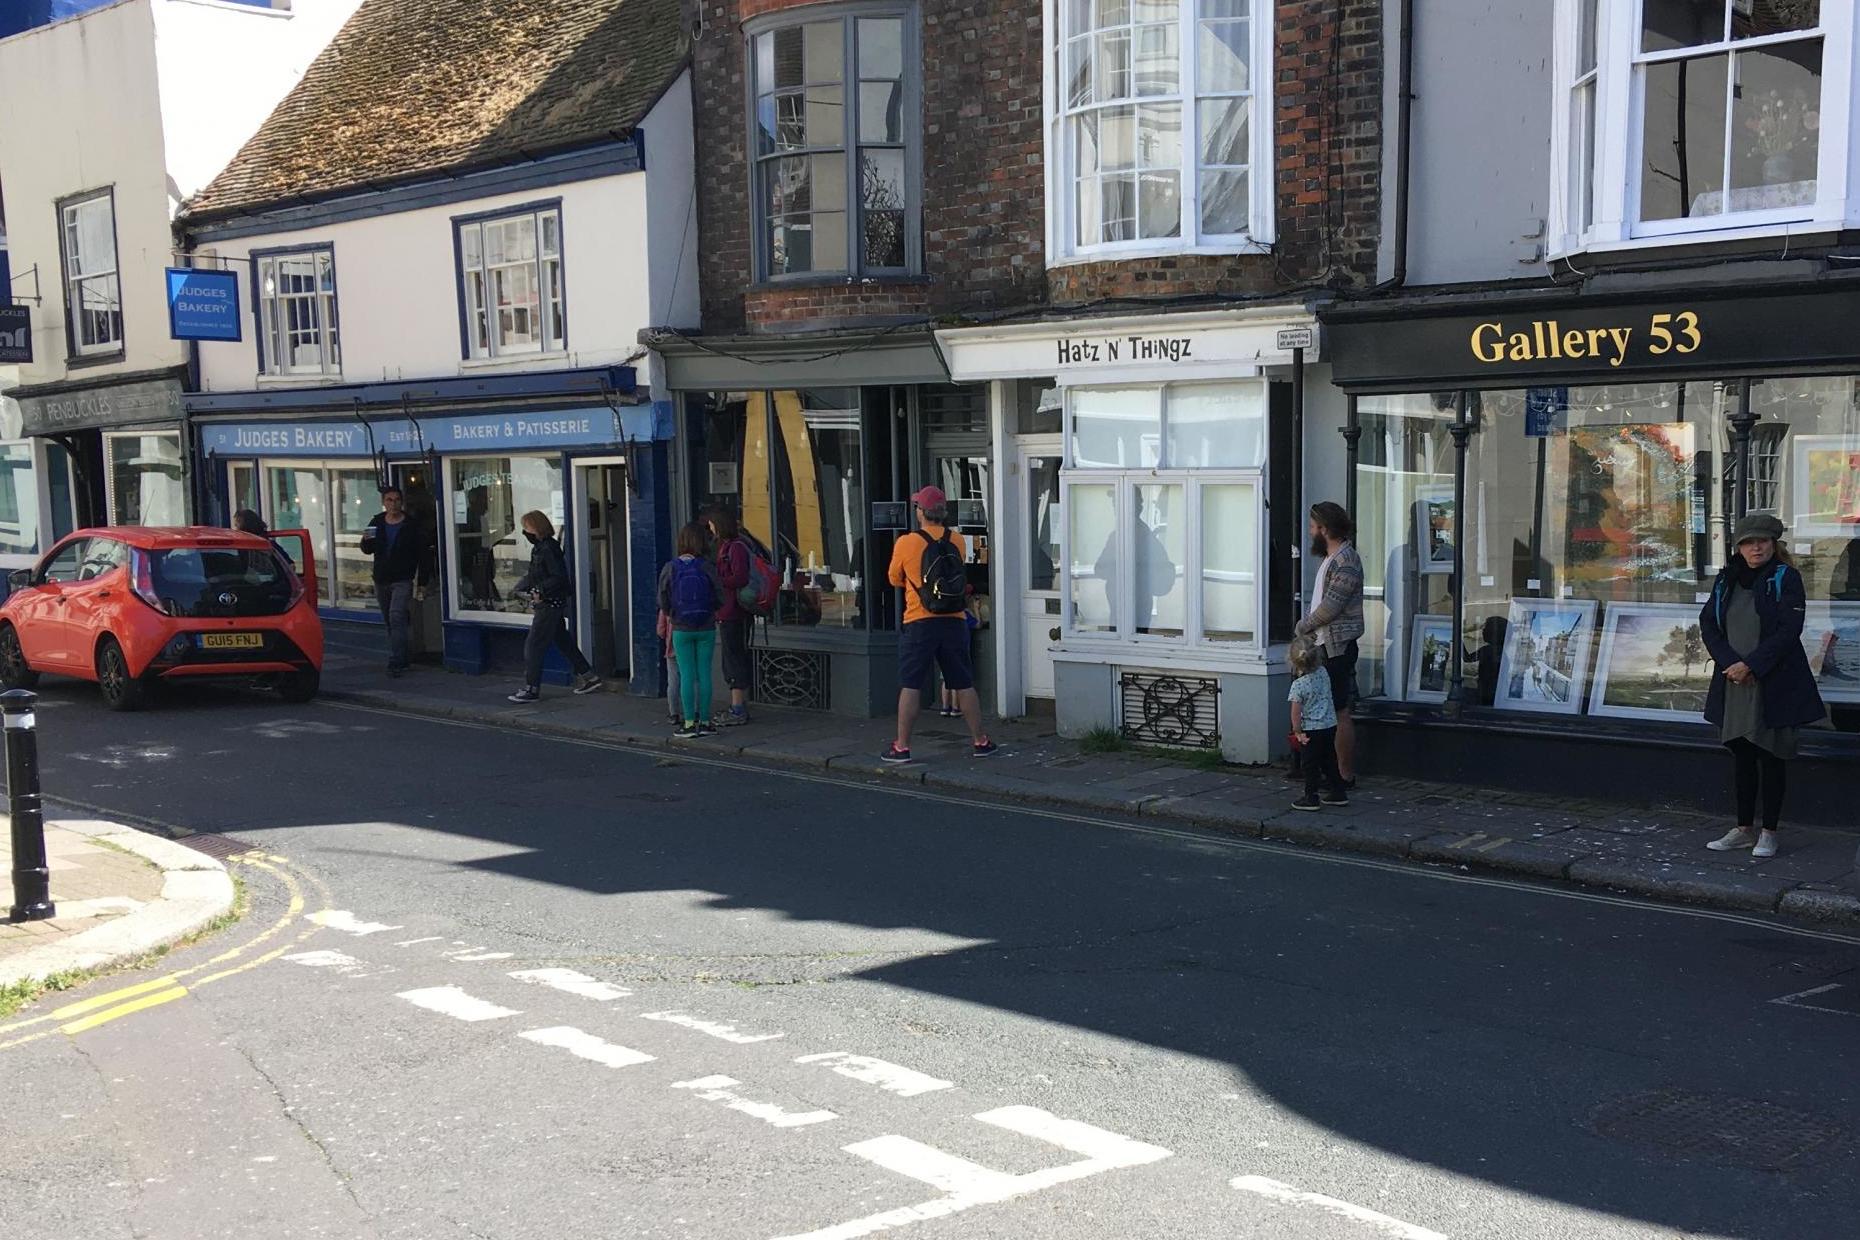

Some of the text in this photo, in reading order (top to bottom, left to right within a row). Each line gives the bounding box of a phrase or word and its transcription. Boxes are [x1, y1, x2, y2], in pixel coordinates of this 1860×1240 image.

[178, 286, 227, 298] JUDGES
[178, 302, 227, 313] BAKERY
[1470, 311, 1702, 367] Gallery 53
[1057, 339, 1100, 363] Hatz
[1104, 338, 1122, 361] 'N'
[47, 396, 113, 421] PENBUCKLES
[234, 428, 289, 448] JUDGES
[295, 428, 352, 448] BAKERY
[454, 419, 590, 439] BAKERY & PATISSERIE
[463, 473, 499, 491] JUDGES
[207, 635, 259, 646] GU15 FNJ
